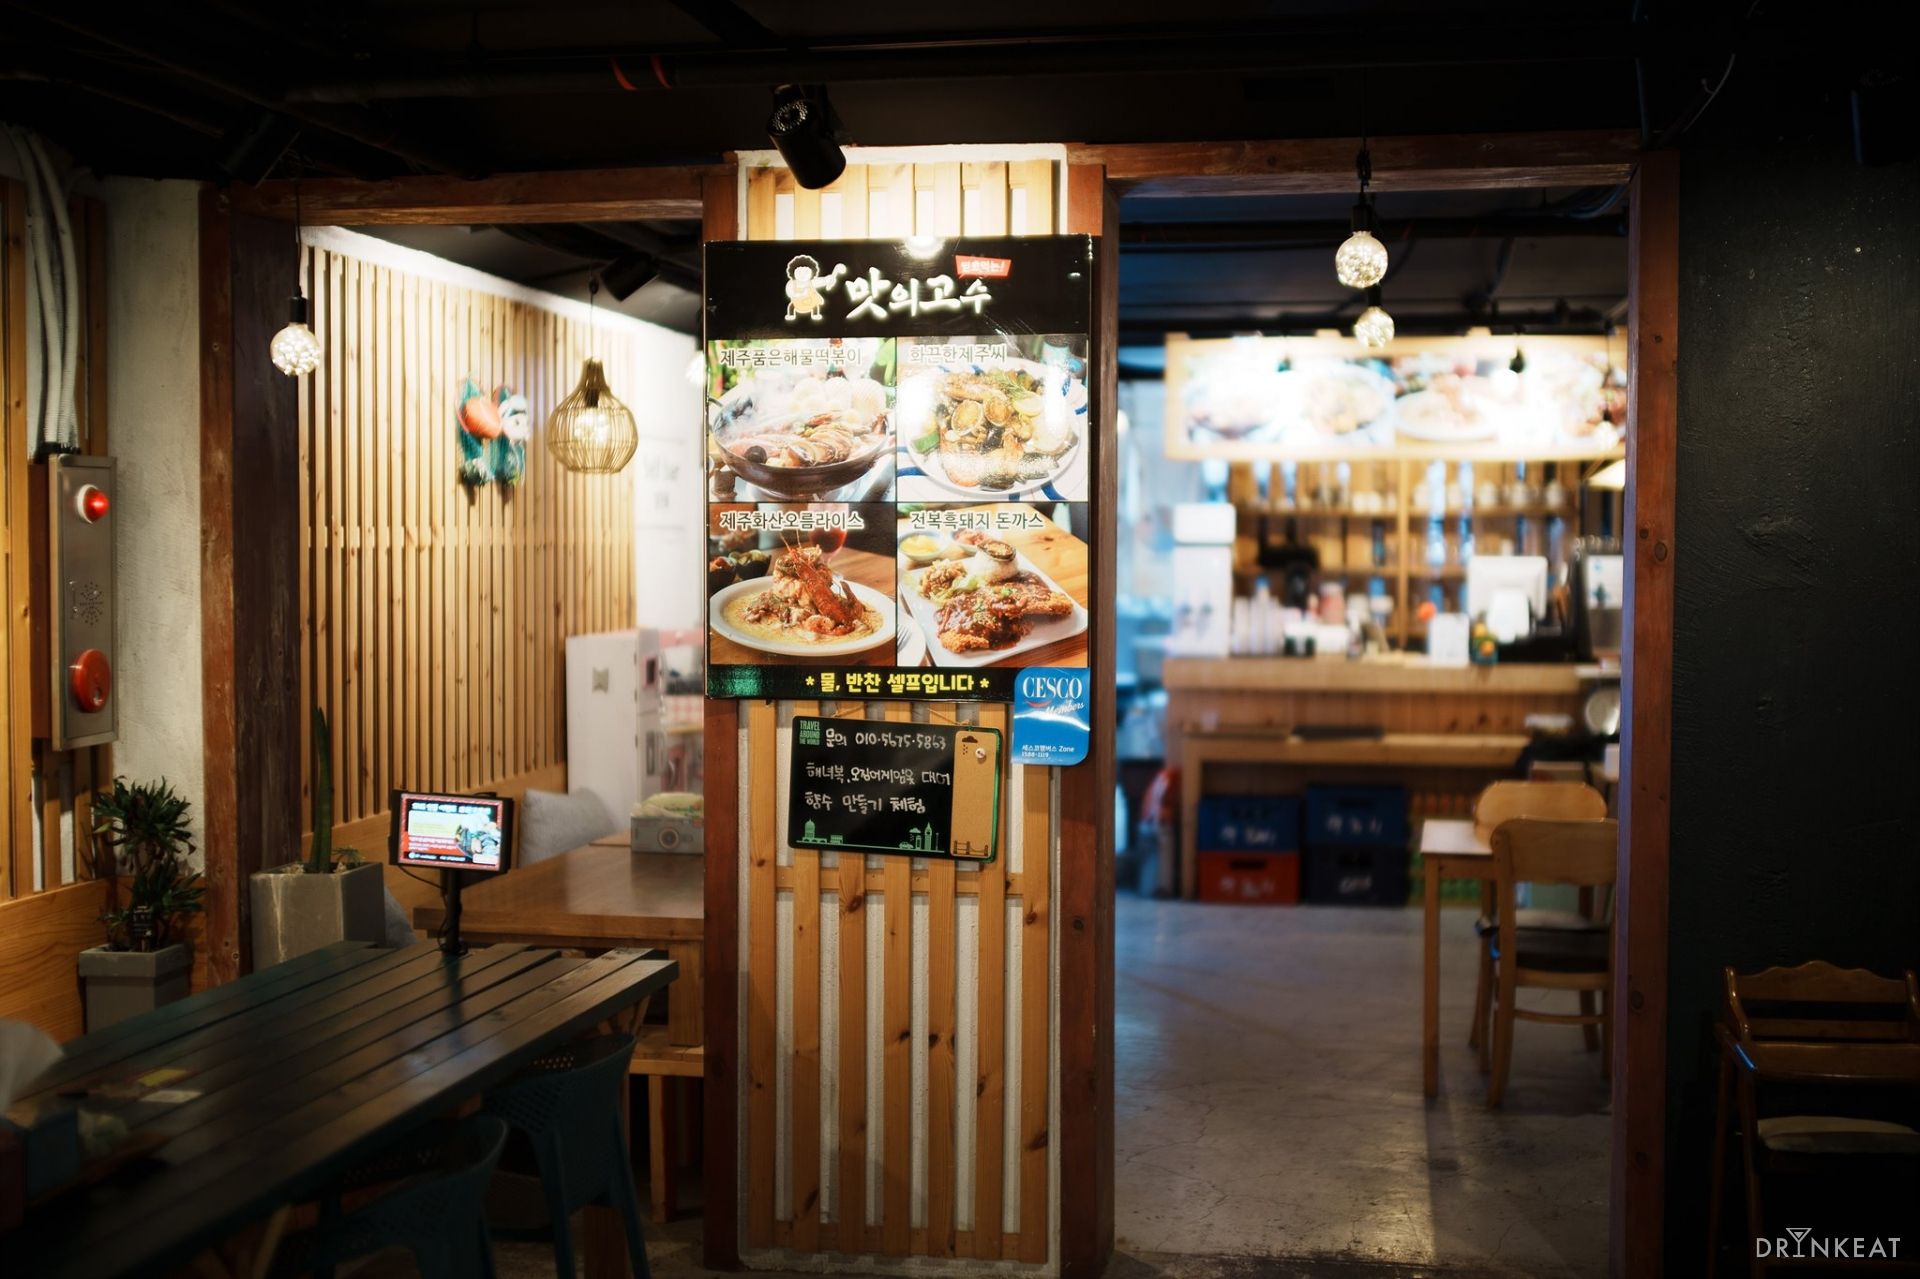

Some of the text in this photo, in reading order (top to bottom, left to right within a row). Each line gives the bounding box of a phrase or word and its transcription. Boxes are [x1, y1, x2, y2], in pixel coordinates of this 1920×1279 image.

[845, 266, 993, 319] 맛의고수
[720, 348, 862, 367] 제주품은해물떡볶이
[911, 344, 1007, 364] 화끈한제주씨
[721, 511, 864, 530] 제주화산오름라이스
[911, 511, 1044, 529] 전복흑돼지 돈까스
[846, 672, 881, 693] 반찬
[887, 673, 974, 694] 셀프입니다
[1022, 676, 1083, 699] CESCO
[799, 719, 821, 731] TRAVEL
[825, 728, 847, 748] 문의
[1058, 745, 1075, 753] Zone
[804, 791, 832, 811] 향수
[842, 794, 882, 815] 만들기
